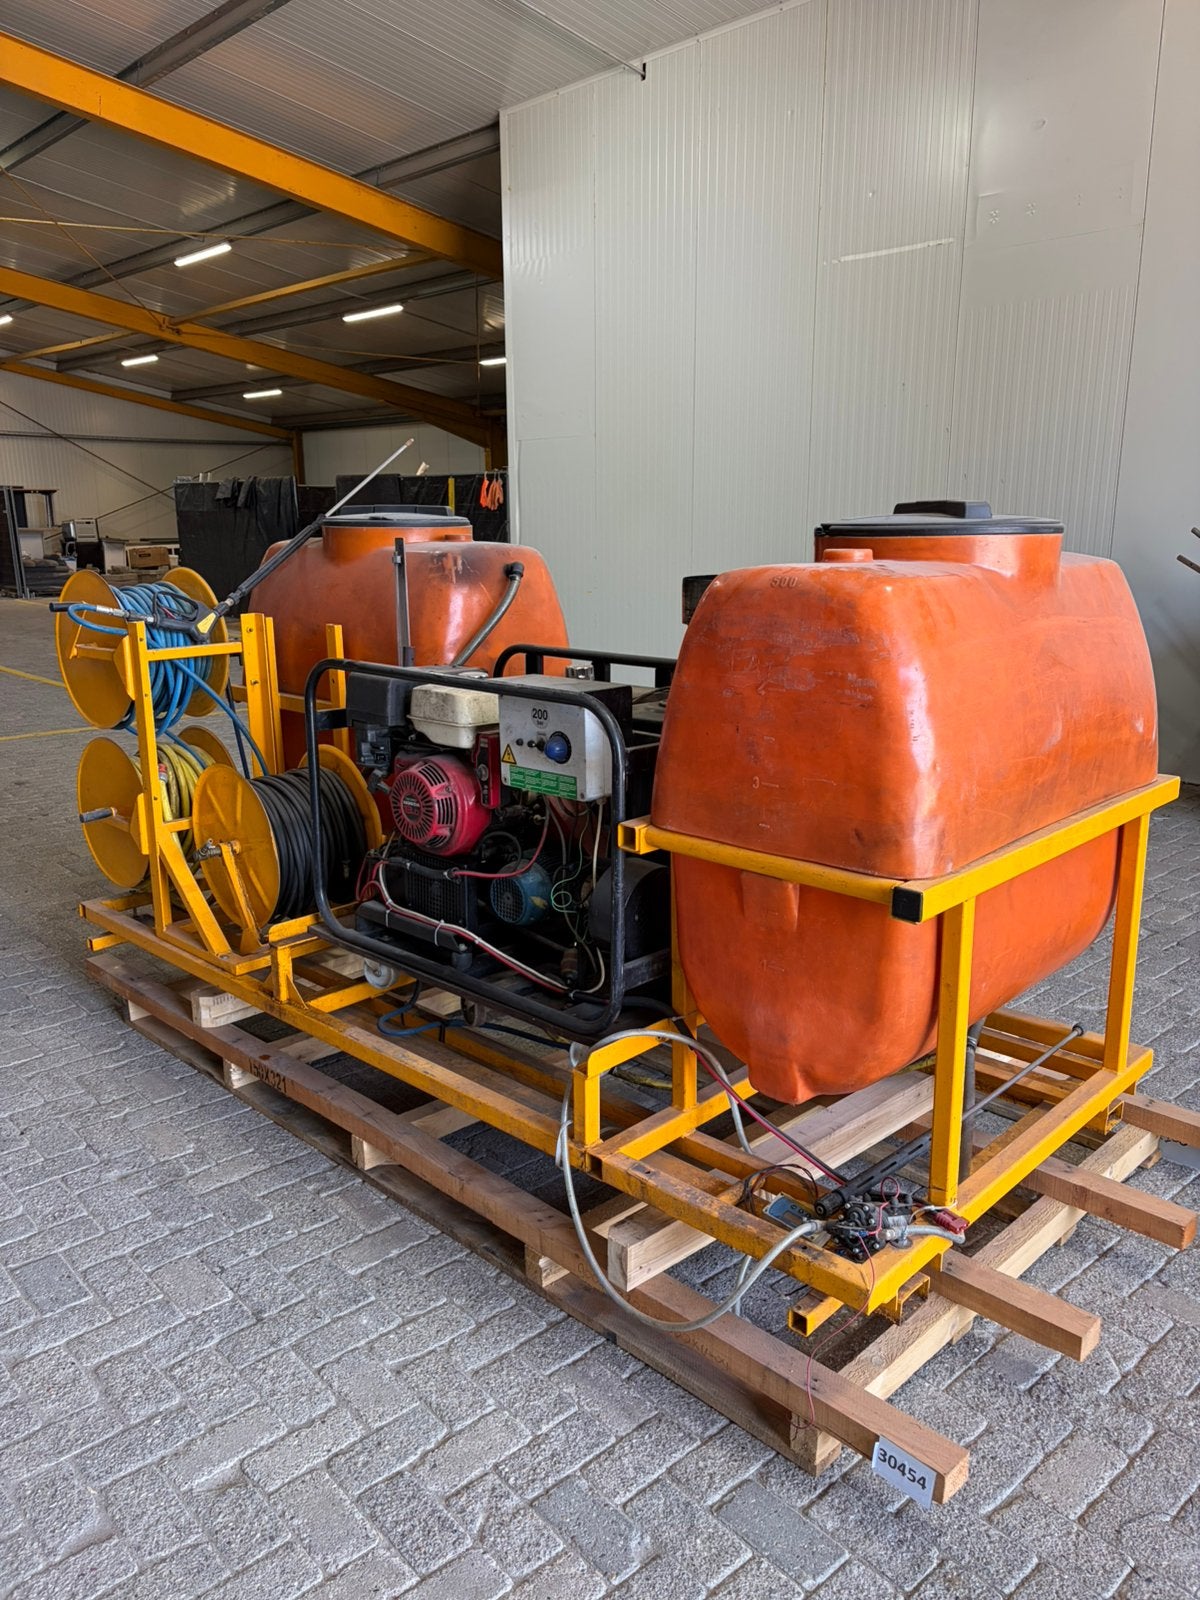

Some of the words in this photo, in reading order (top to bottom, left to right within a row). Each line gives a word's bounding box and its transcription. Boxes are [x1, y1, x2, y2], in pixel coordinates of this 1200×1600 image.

[770, 575, 798, 589] 500
[532, 707, 549, 721] 200
[878, 1447, 927, 1491] 30454
